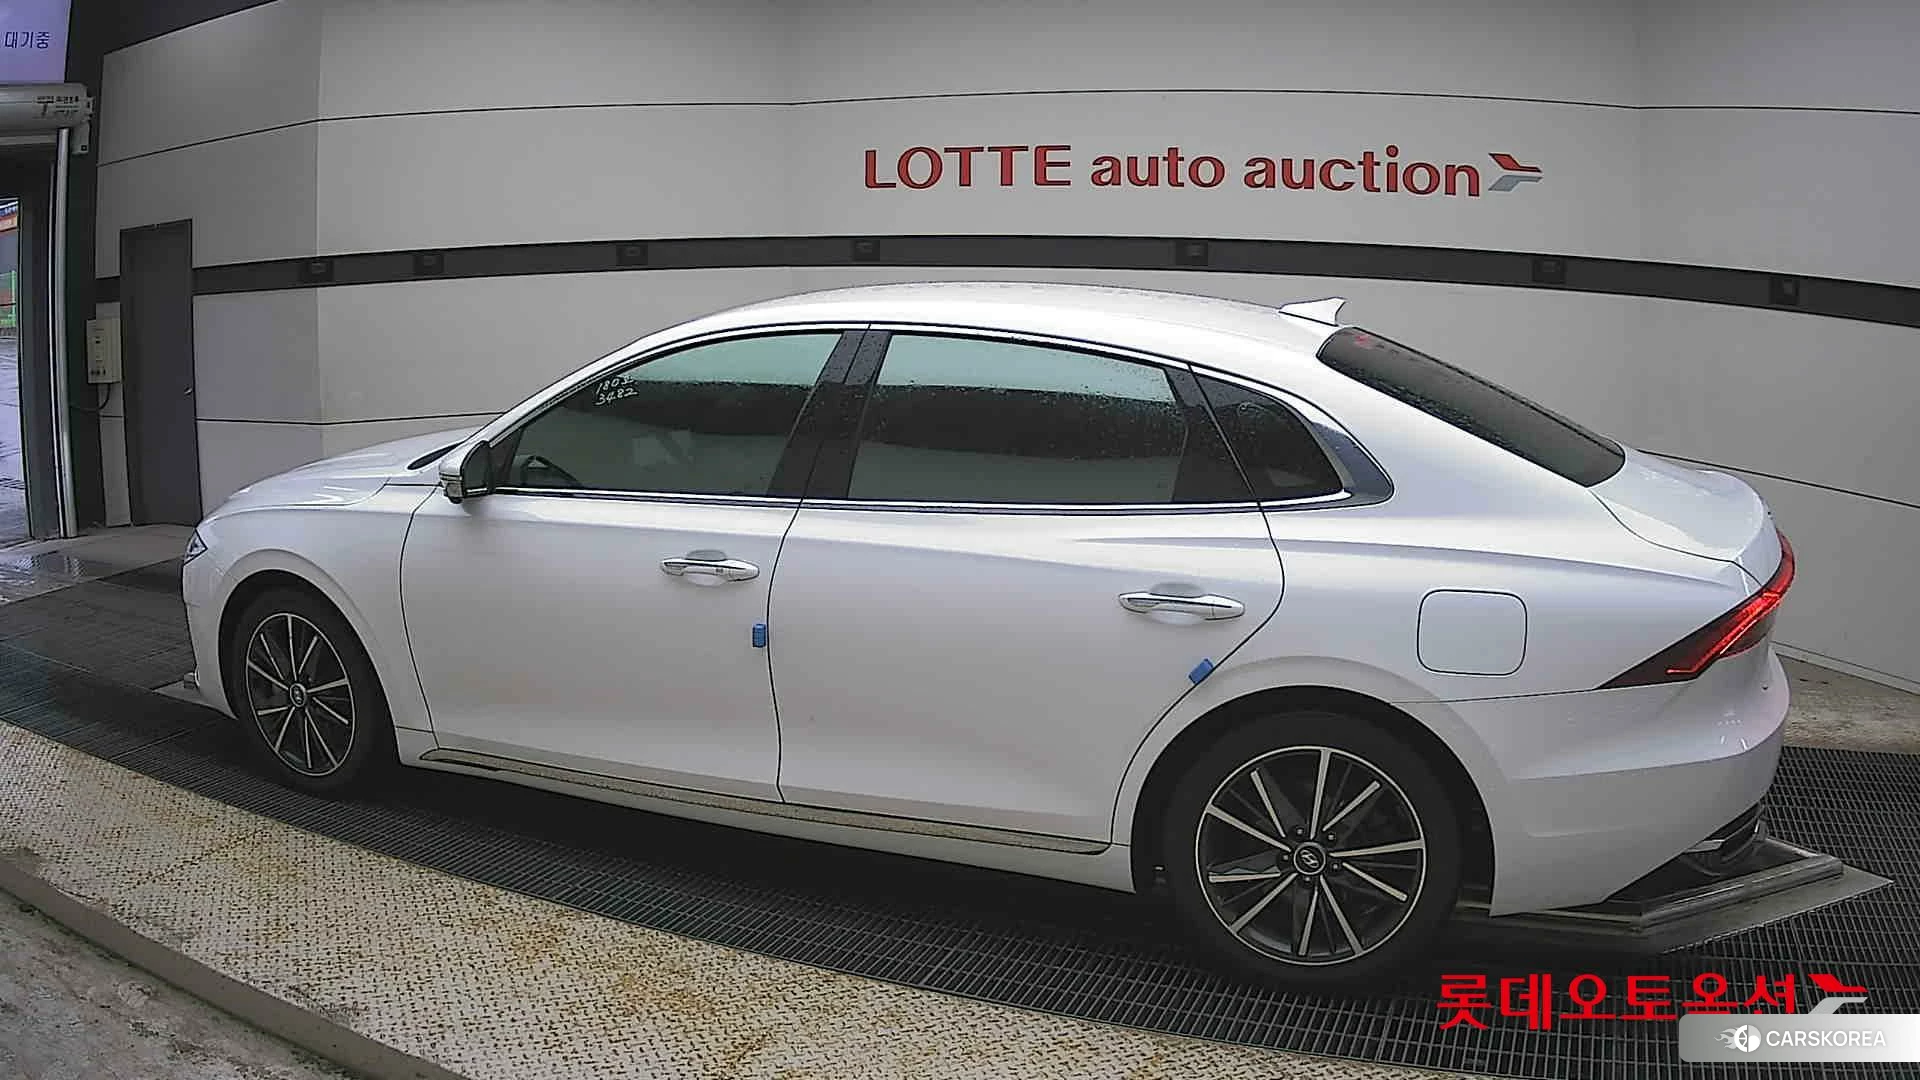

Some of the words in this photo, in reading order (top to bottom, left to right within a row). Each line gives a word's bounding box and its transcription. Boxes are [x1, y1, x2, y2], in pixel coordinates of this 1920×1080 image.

[4, 31, 51, 50] 대기중
[864, 145, 1073, 190] LOTTE
[1090, 147, 1227, 189] auto
[1243, 145, 1481, 198] auction
[594, 387, 639, 406] 3482
